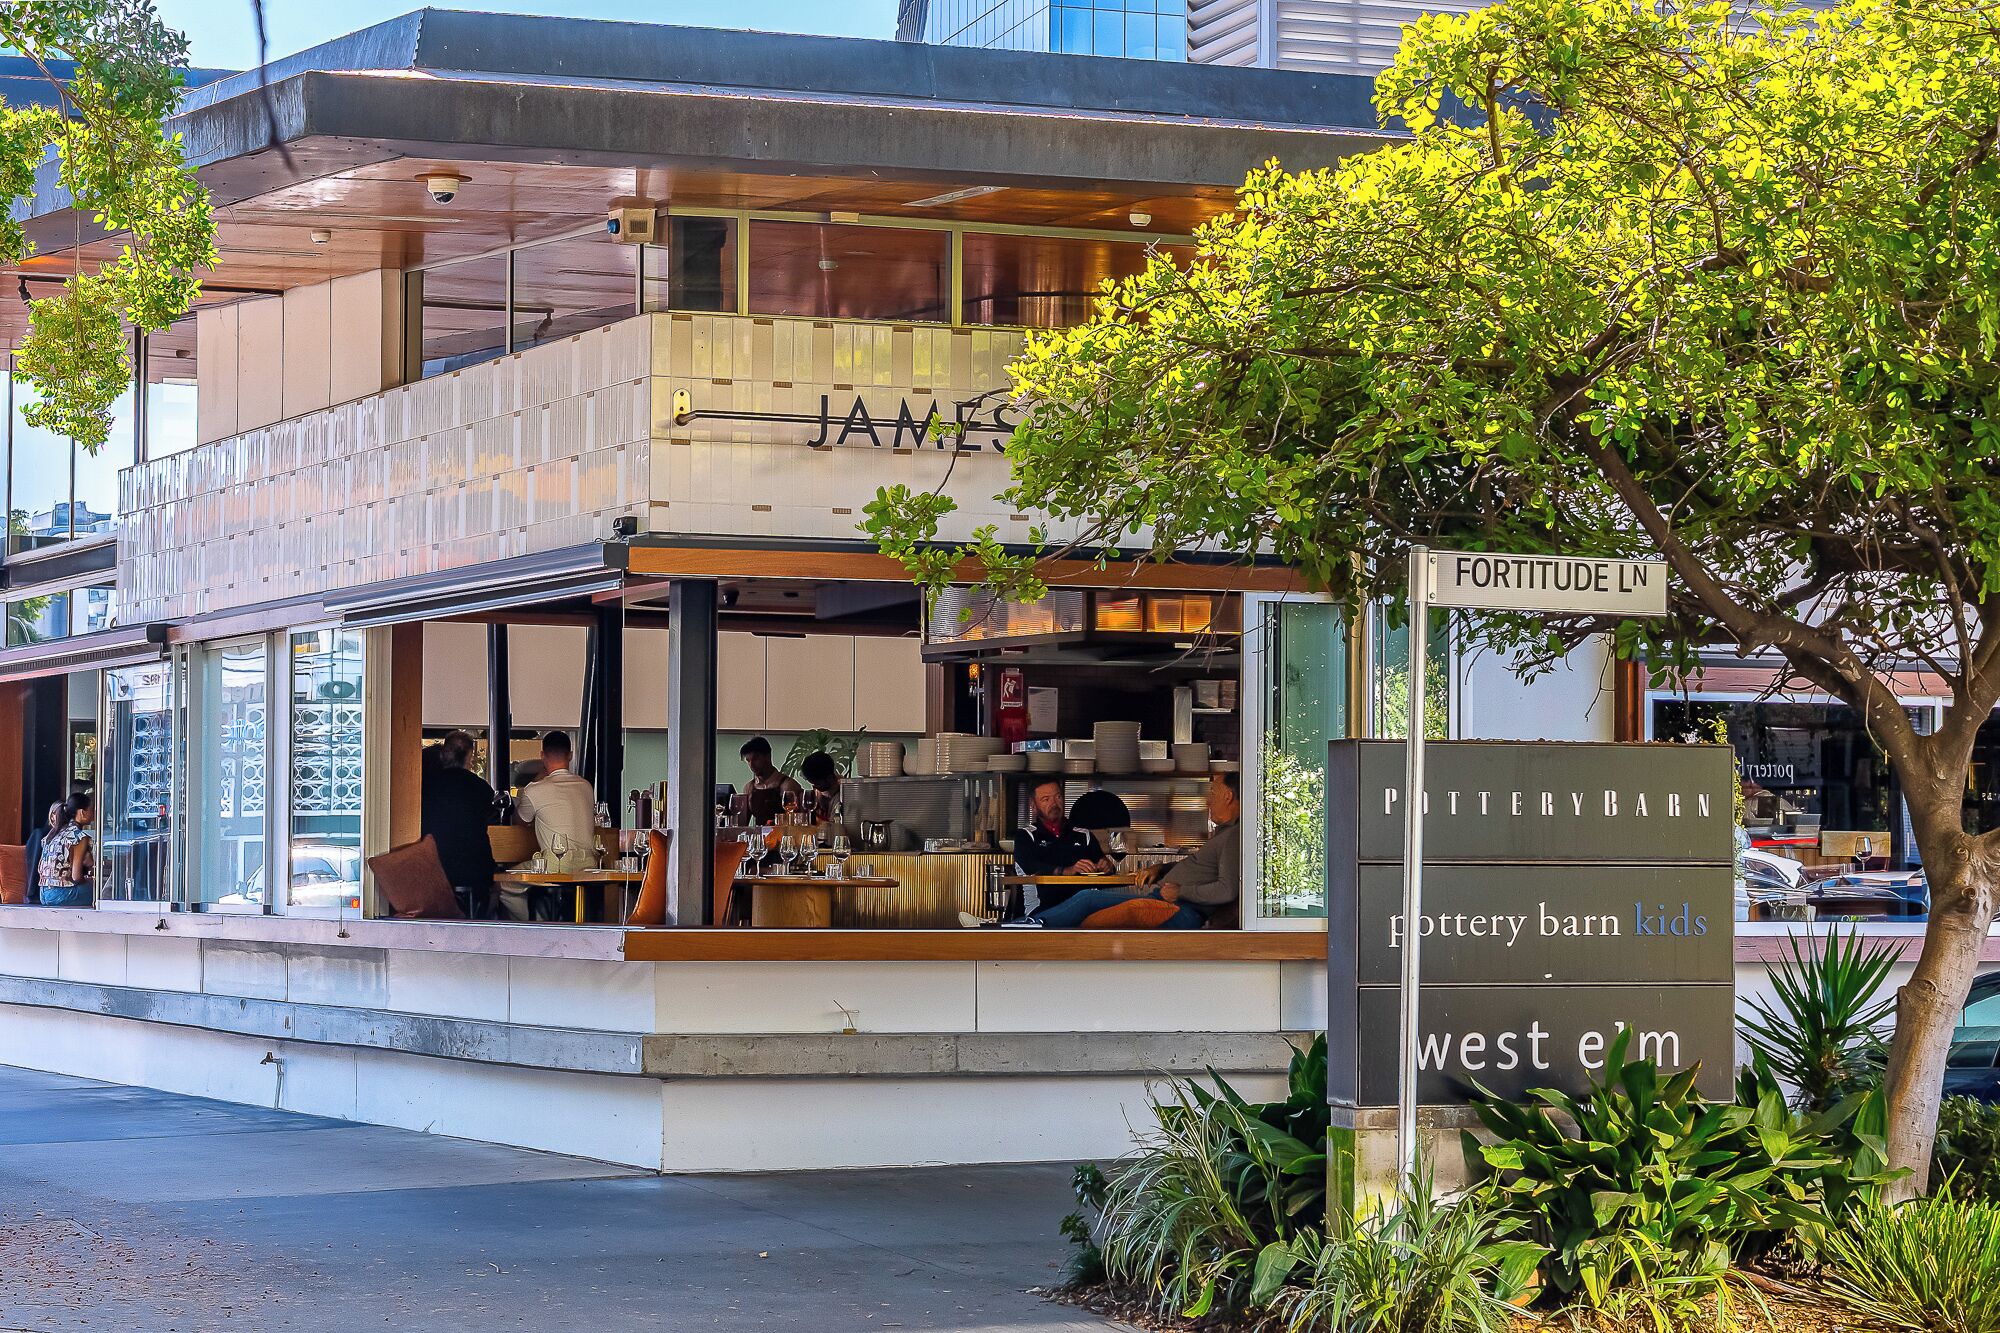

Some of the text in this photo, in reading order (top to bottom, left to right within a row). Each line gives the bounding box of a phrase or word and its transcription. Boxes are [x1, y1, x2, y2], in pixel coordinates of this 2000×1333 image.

[807, 394, 1014, 454] JAMES
[1456, 557, 1648, 593] FORTITUDE LN
[1388, 901, 1708, 948] pottery barn kids
[1416, 1020, 1550, 1071] west
